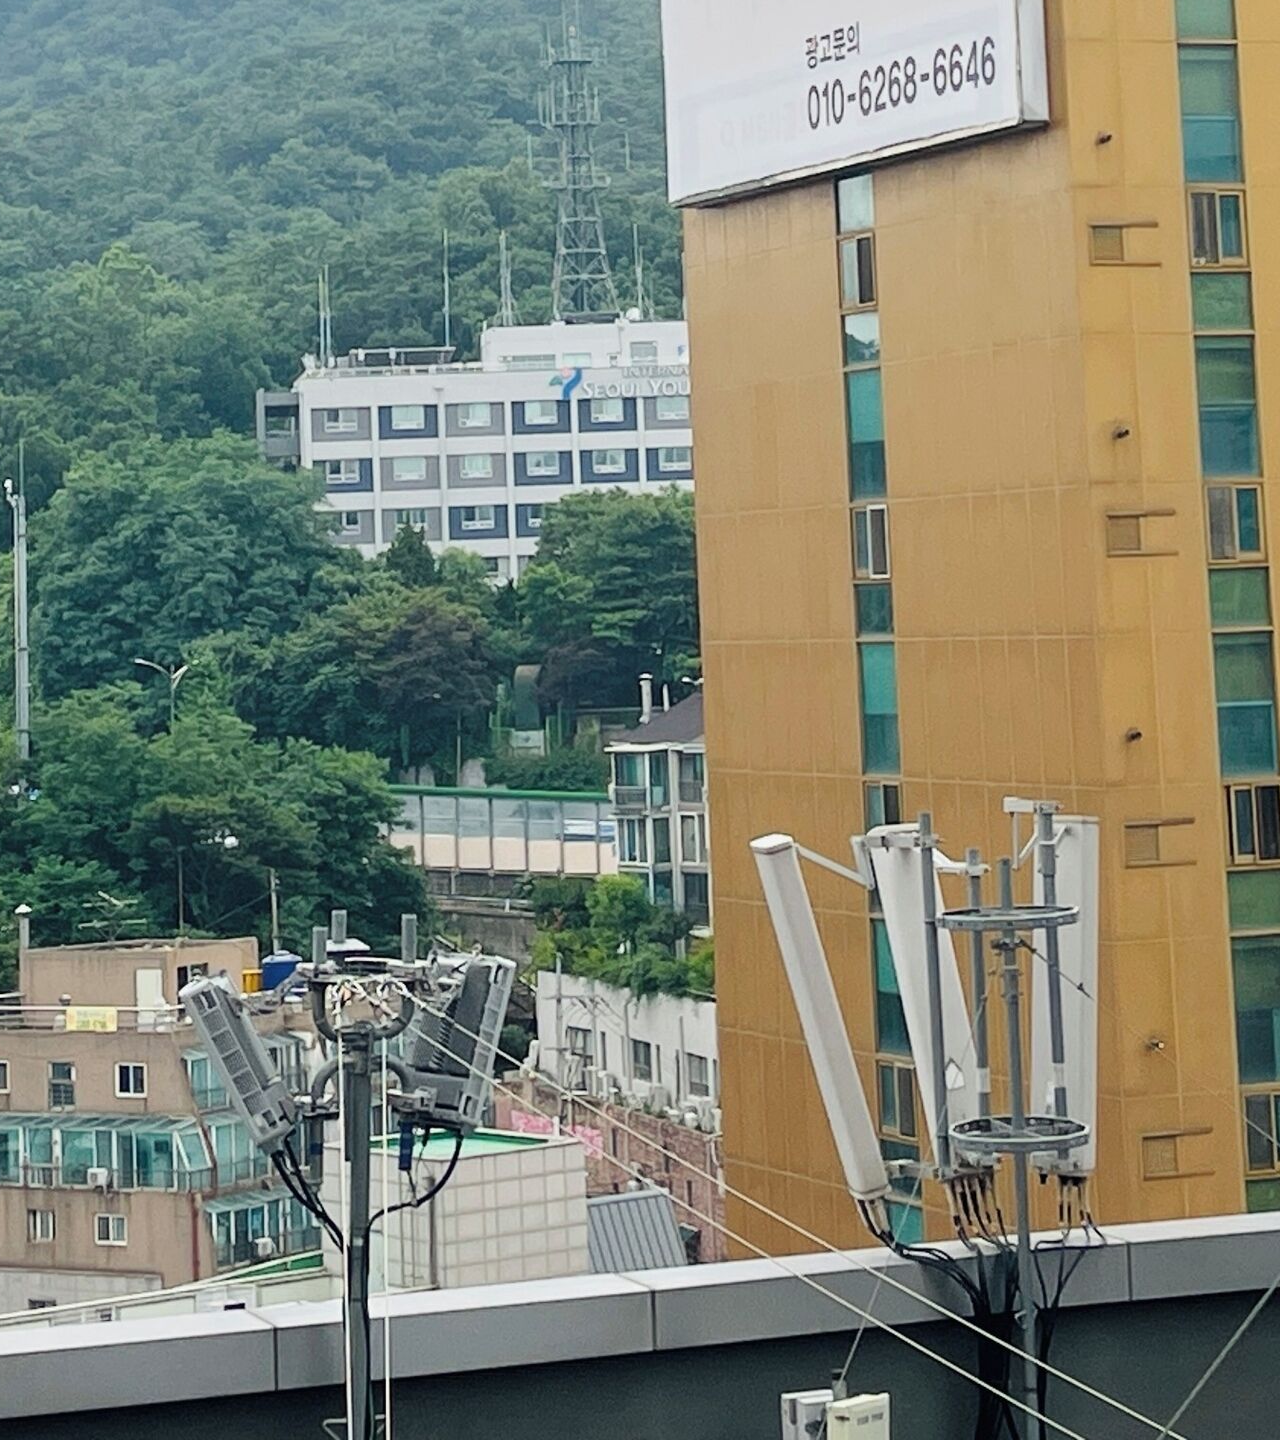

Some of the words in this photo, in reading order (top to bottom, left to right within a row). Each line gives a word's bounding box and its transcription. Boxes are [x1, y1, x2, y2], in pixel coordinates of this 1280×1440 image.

[805, 21, 860, 69] 광고문의
[807, 36, 996, 130] 010-6268-6646
[582, 381, 641, 398] SEOUL
[648, 379, 691, 396] YOU
